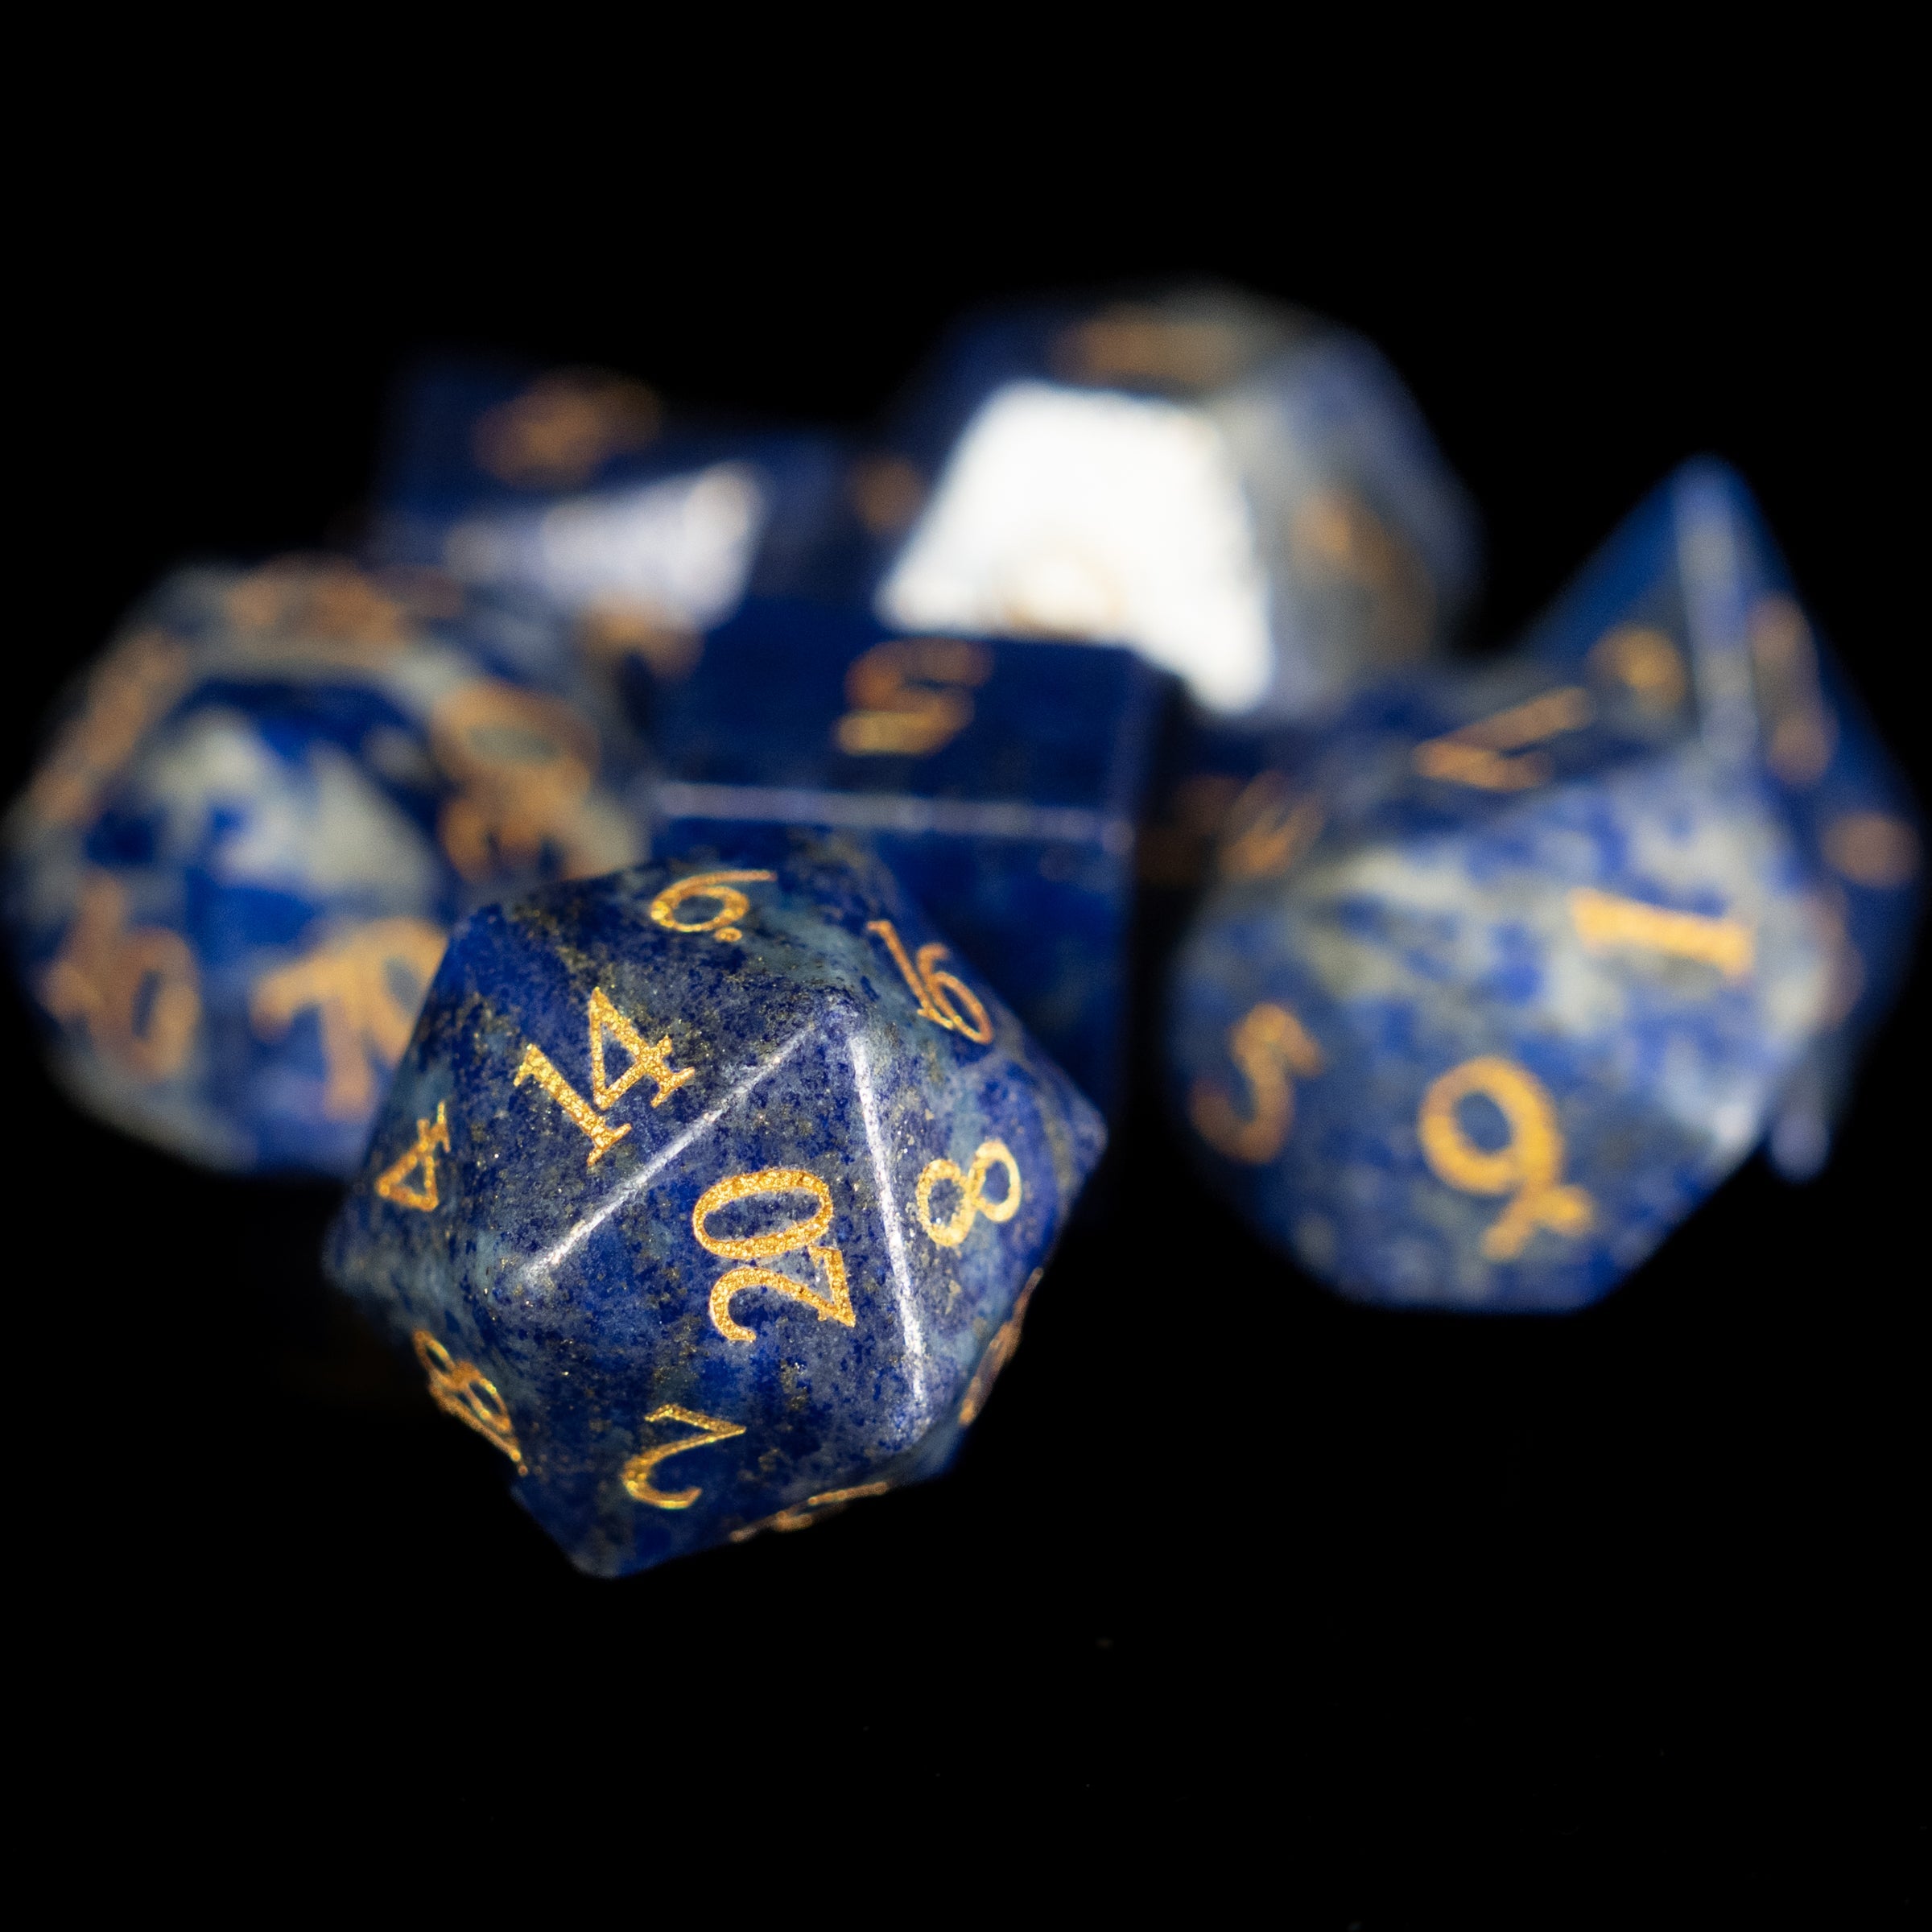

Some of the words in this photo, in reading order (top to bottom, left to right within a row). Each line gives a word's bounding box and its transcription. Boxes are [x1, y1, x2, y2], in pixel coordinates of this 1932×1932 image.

[867, 919, 994, 1045] 16
[1568, 886, 1757, 986] 1
[514, 985, 695, 1166] 14
[376, 1099, 451, 1212] 4
[915, 1139, 1020, 1247] 8
[692, 1169, 855, 1343] 20
[622, 1404, 745, 1509] 2
